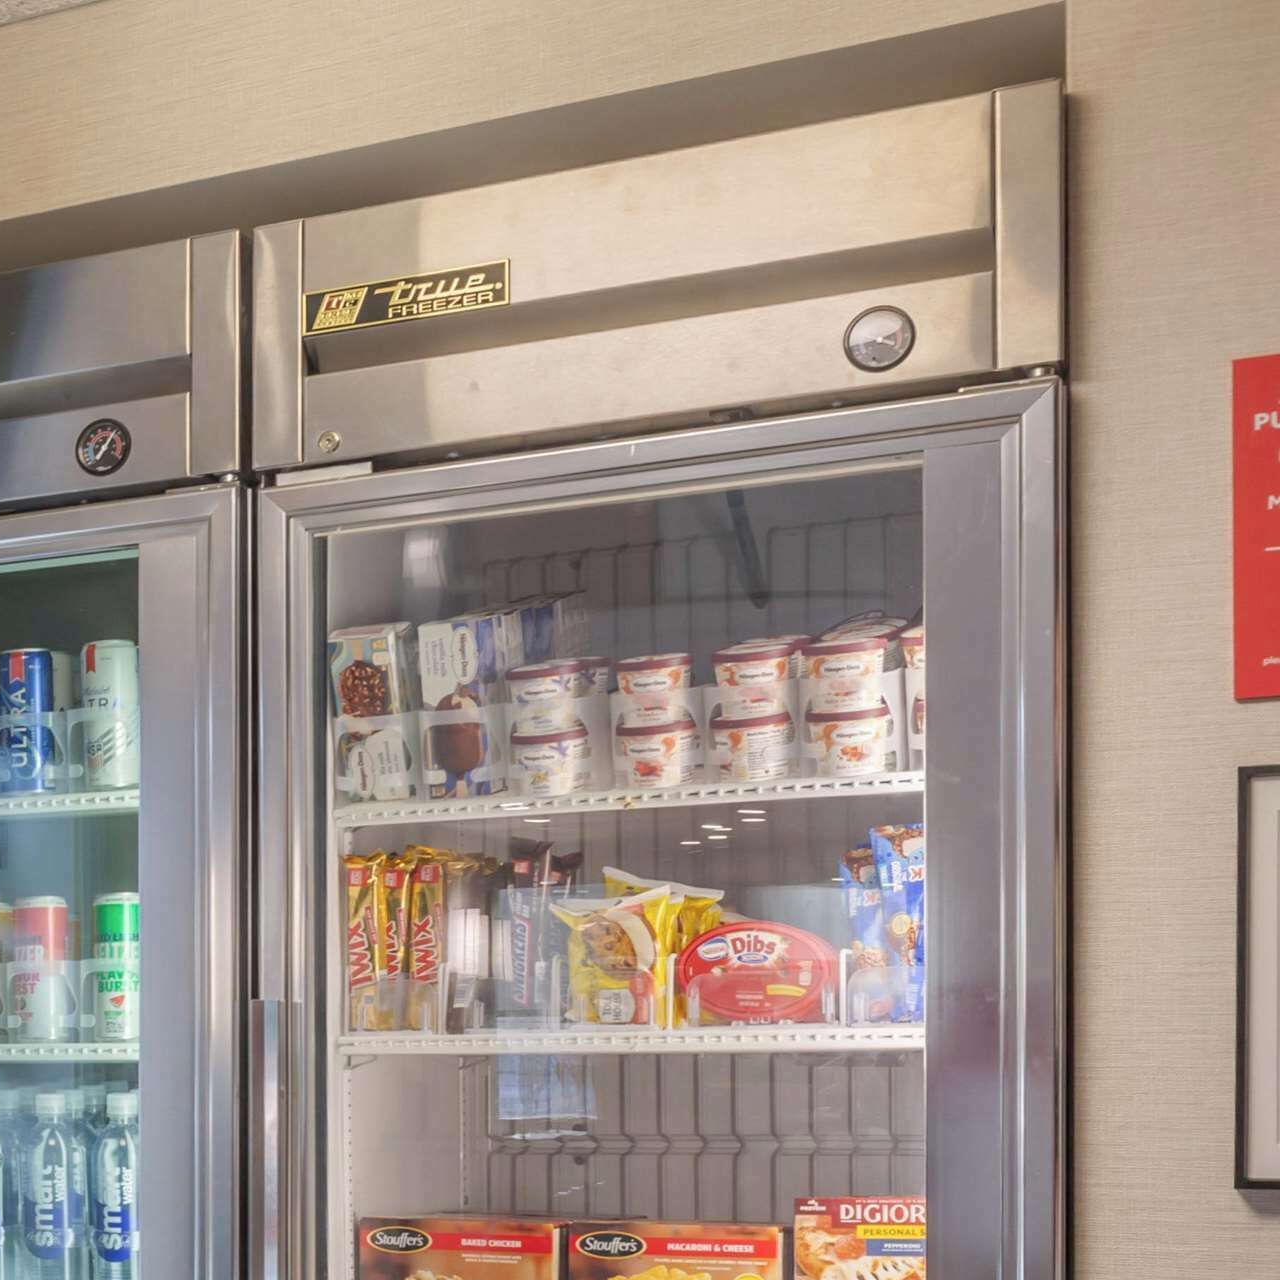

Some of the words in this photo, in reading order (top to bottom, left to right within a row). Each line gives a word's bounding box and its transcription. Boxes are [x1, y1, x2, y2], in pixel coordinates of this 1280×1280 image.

[388, 292, 494, 318] FREEZER
[10, 688, 28, 768] ULTRA
[730, 933, 777, 955] Dibs
[54, 1166, 65, 1203] water
[122, 1166, 133, 1205] water
[35, 1165, 55, 1248] smart
[101, 1166, 122, 1250] smart
[375, 1231, 424, 1249] Stouffer's
[461, 1238, 487, 1247] BAKED
[488, 1238, 522, 1248] CHICKEN
[584, 1236, 639, 1254] Stouffer's
[667, 1243, 712, 1252] MACARONI
[713, 1243, 721, 1252] &
[722, 1244, 754, 1253] CHEESE
